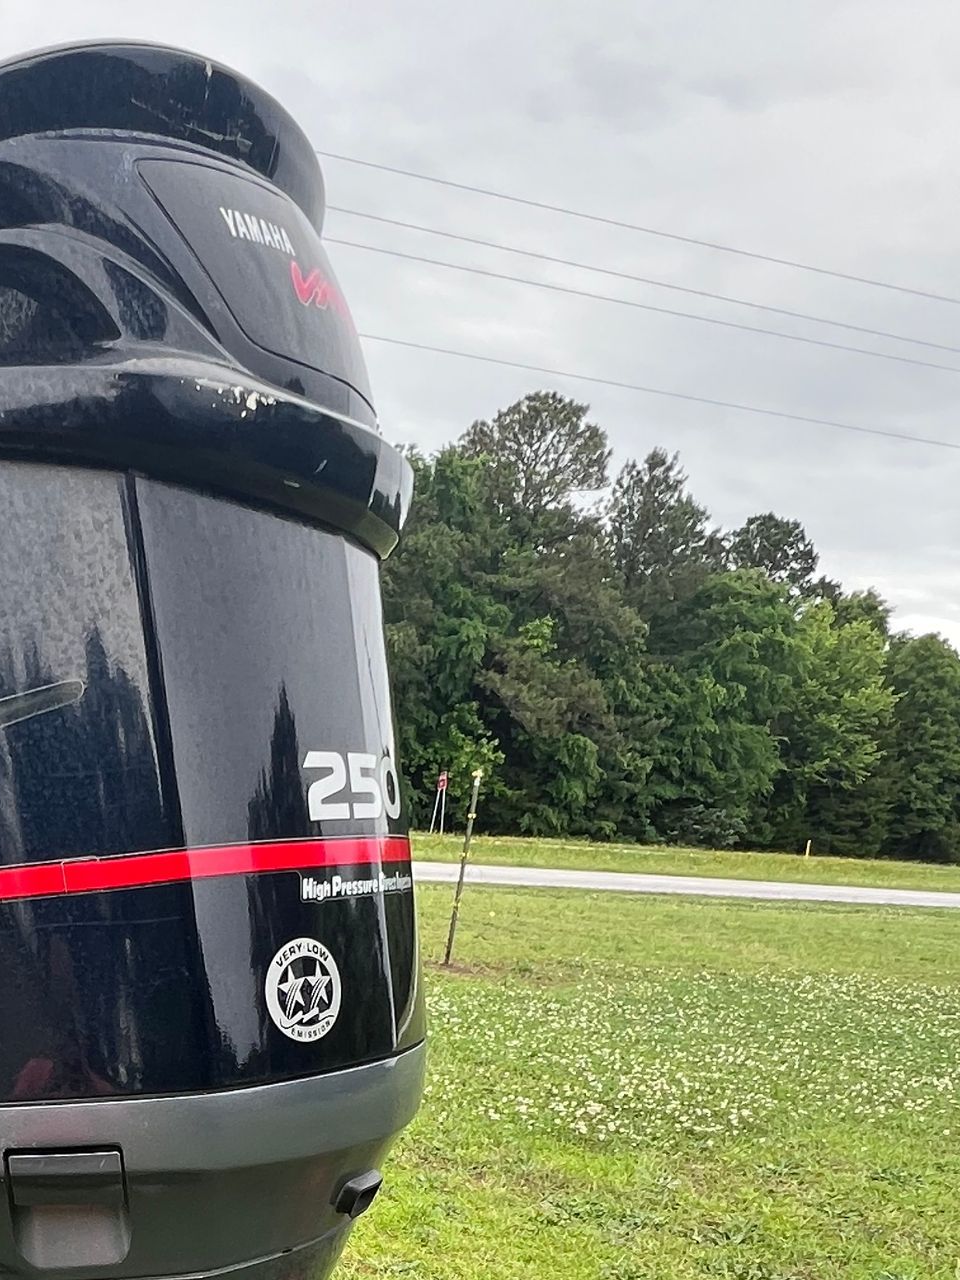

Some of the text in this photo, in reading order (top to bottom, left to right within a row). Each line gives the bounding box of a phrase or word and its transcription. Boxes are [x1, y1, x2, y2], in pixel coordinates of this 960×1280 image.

[219, 207, 296, 256] YAMAHA
[302, 751, 401, 821] 250
[302, 877, 331, 900] High
[332, 875, 378, 896] Pressure
[276, 943, 329, 967] VERY LOW
[291, 1019, 330, 1039] EMISSION
